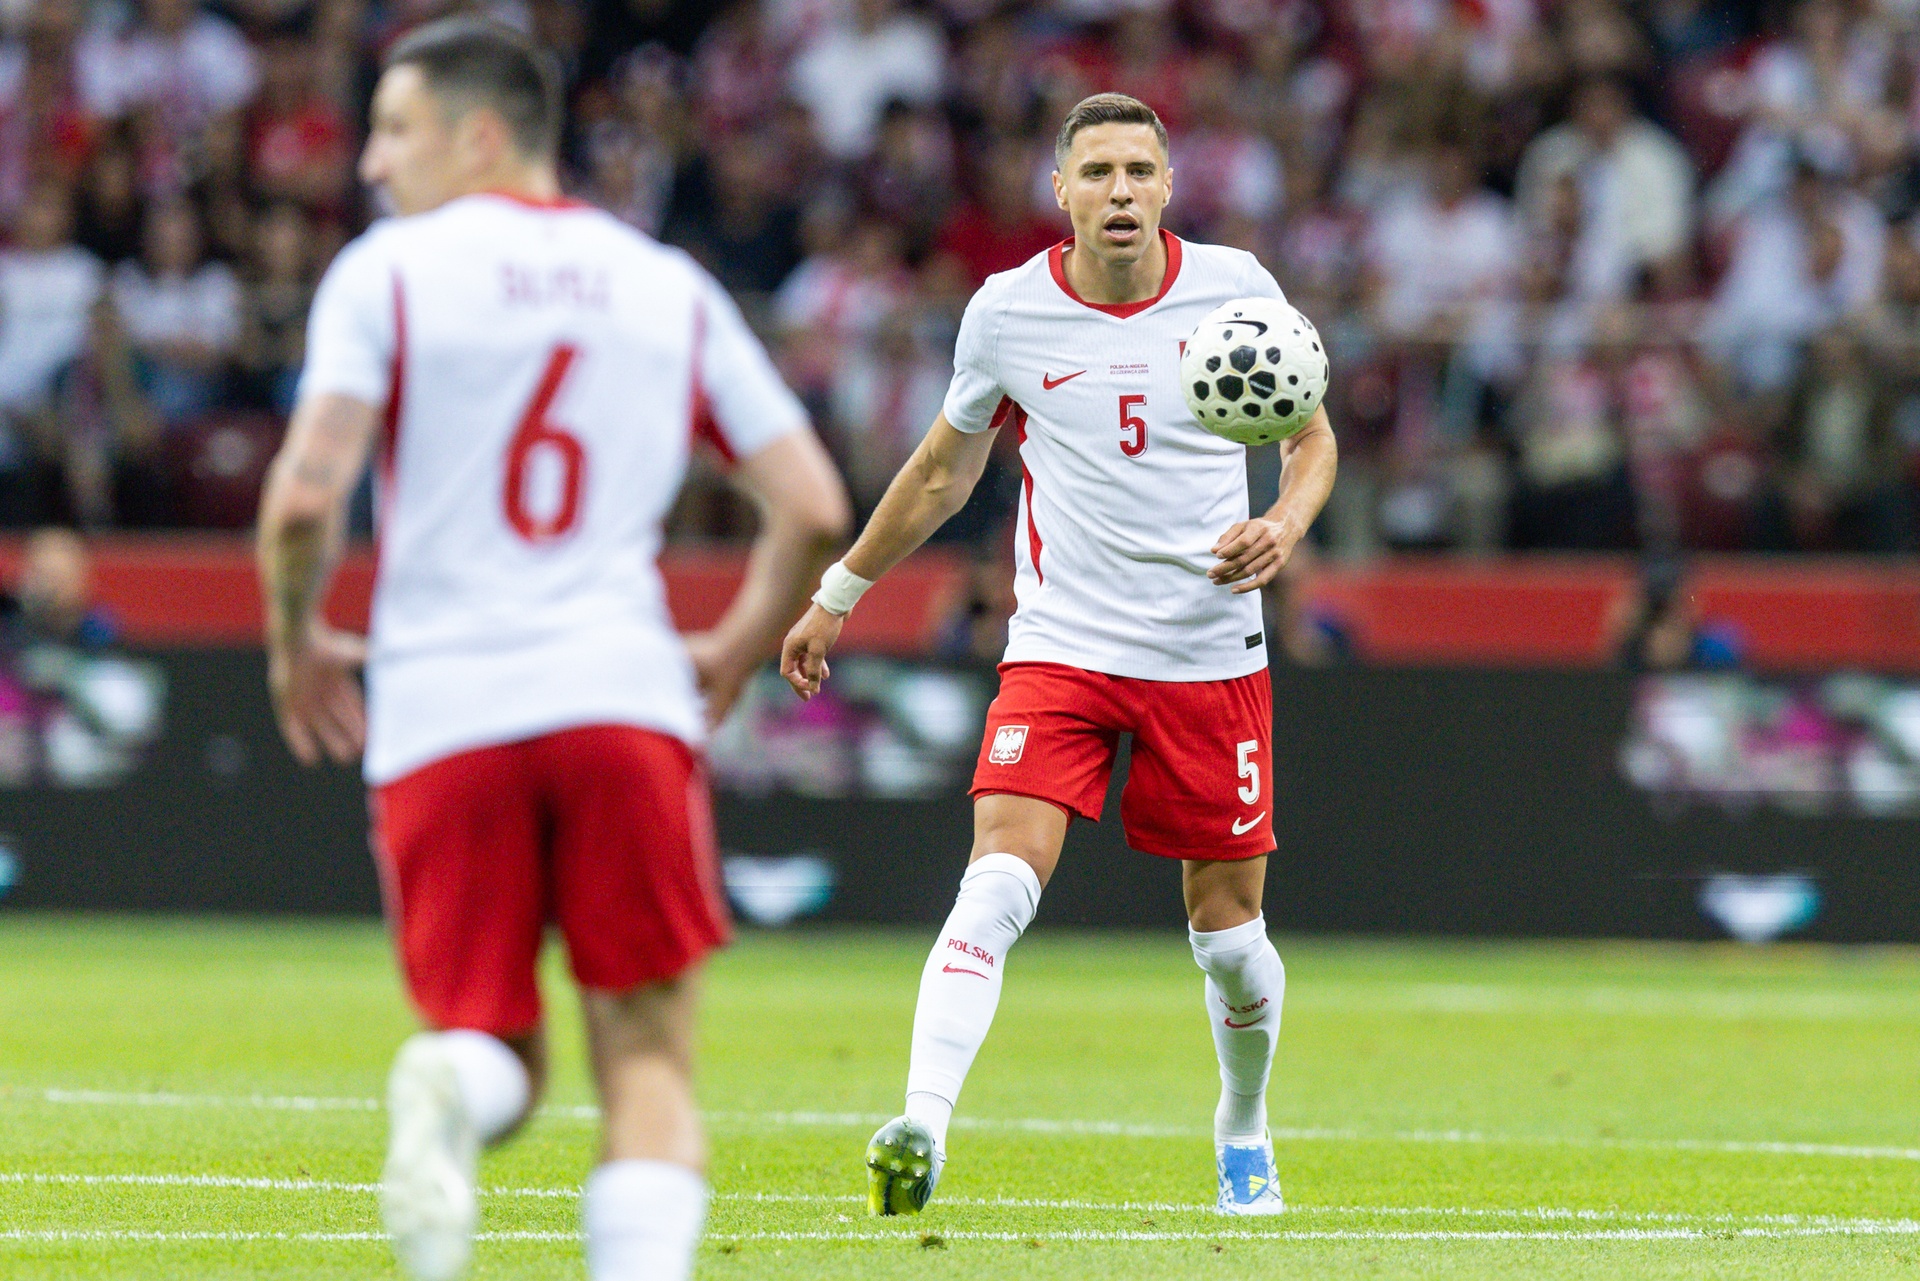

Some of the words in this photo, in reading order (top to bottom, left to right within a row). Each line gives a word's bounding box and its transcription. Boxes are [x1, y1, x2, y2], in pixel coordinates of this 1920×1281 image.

[502, 344, 585, 544] 6
[1119, 394, 1149, 458] 5
[1236, 739, 1261, 805] 5
[947, 938, 994, 967] POLSKA
